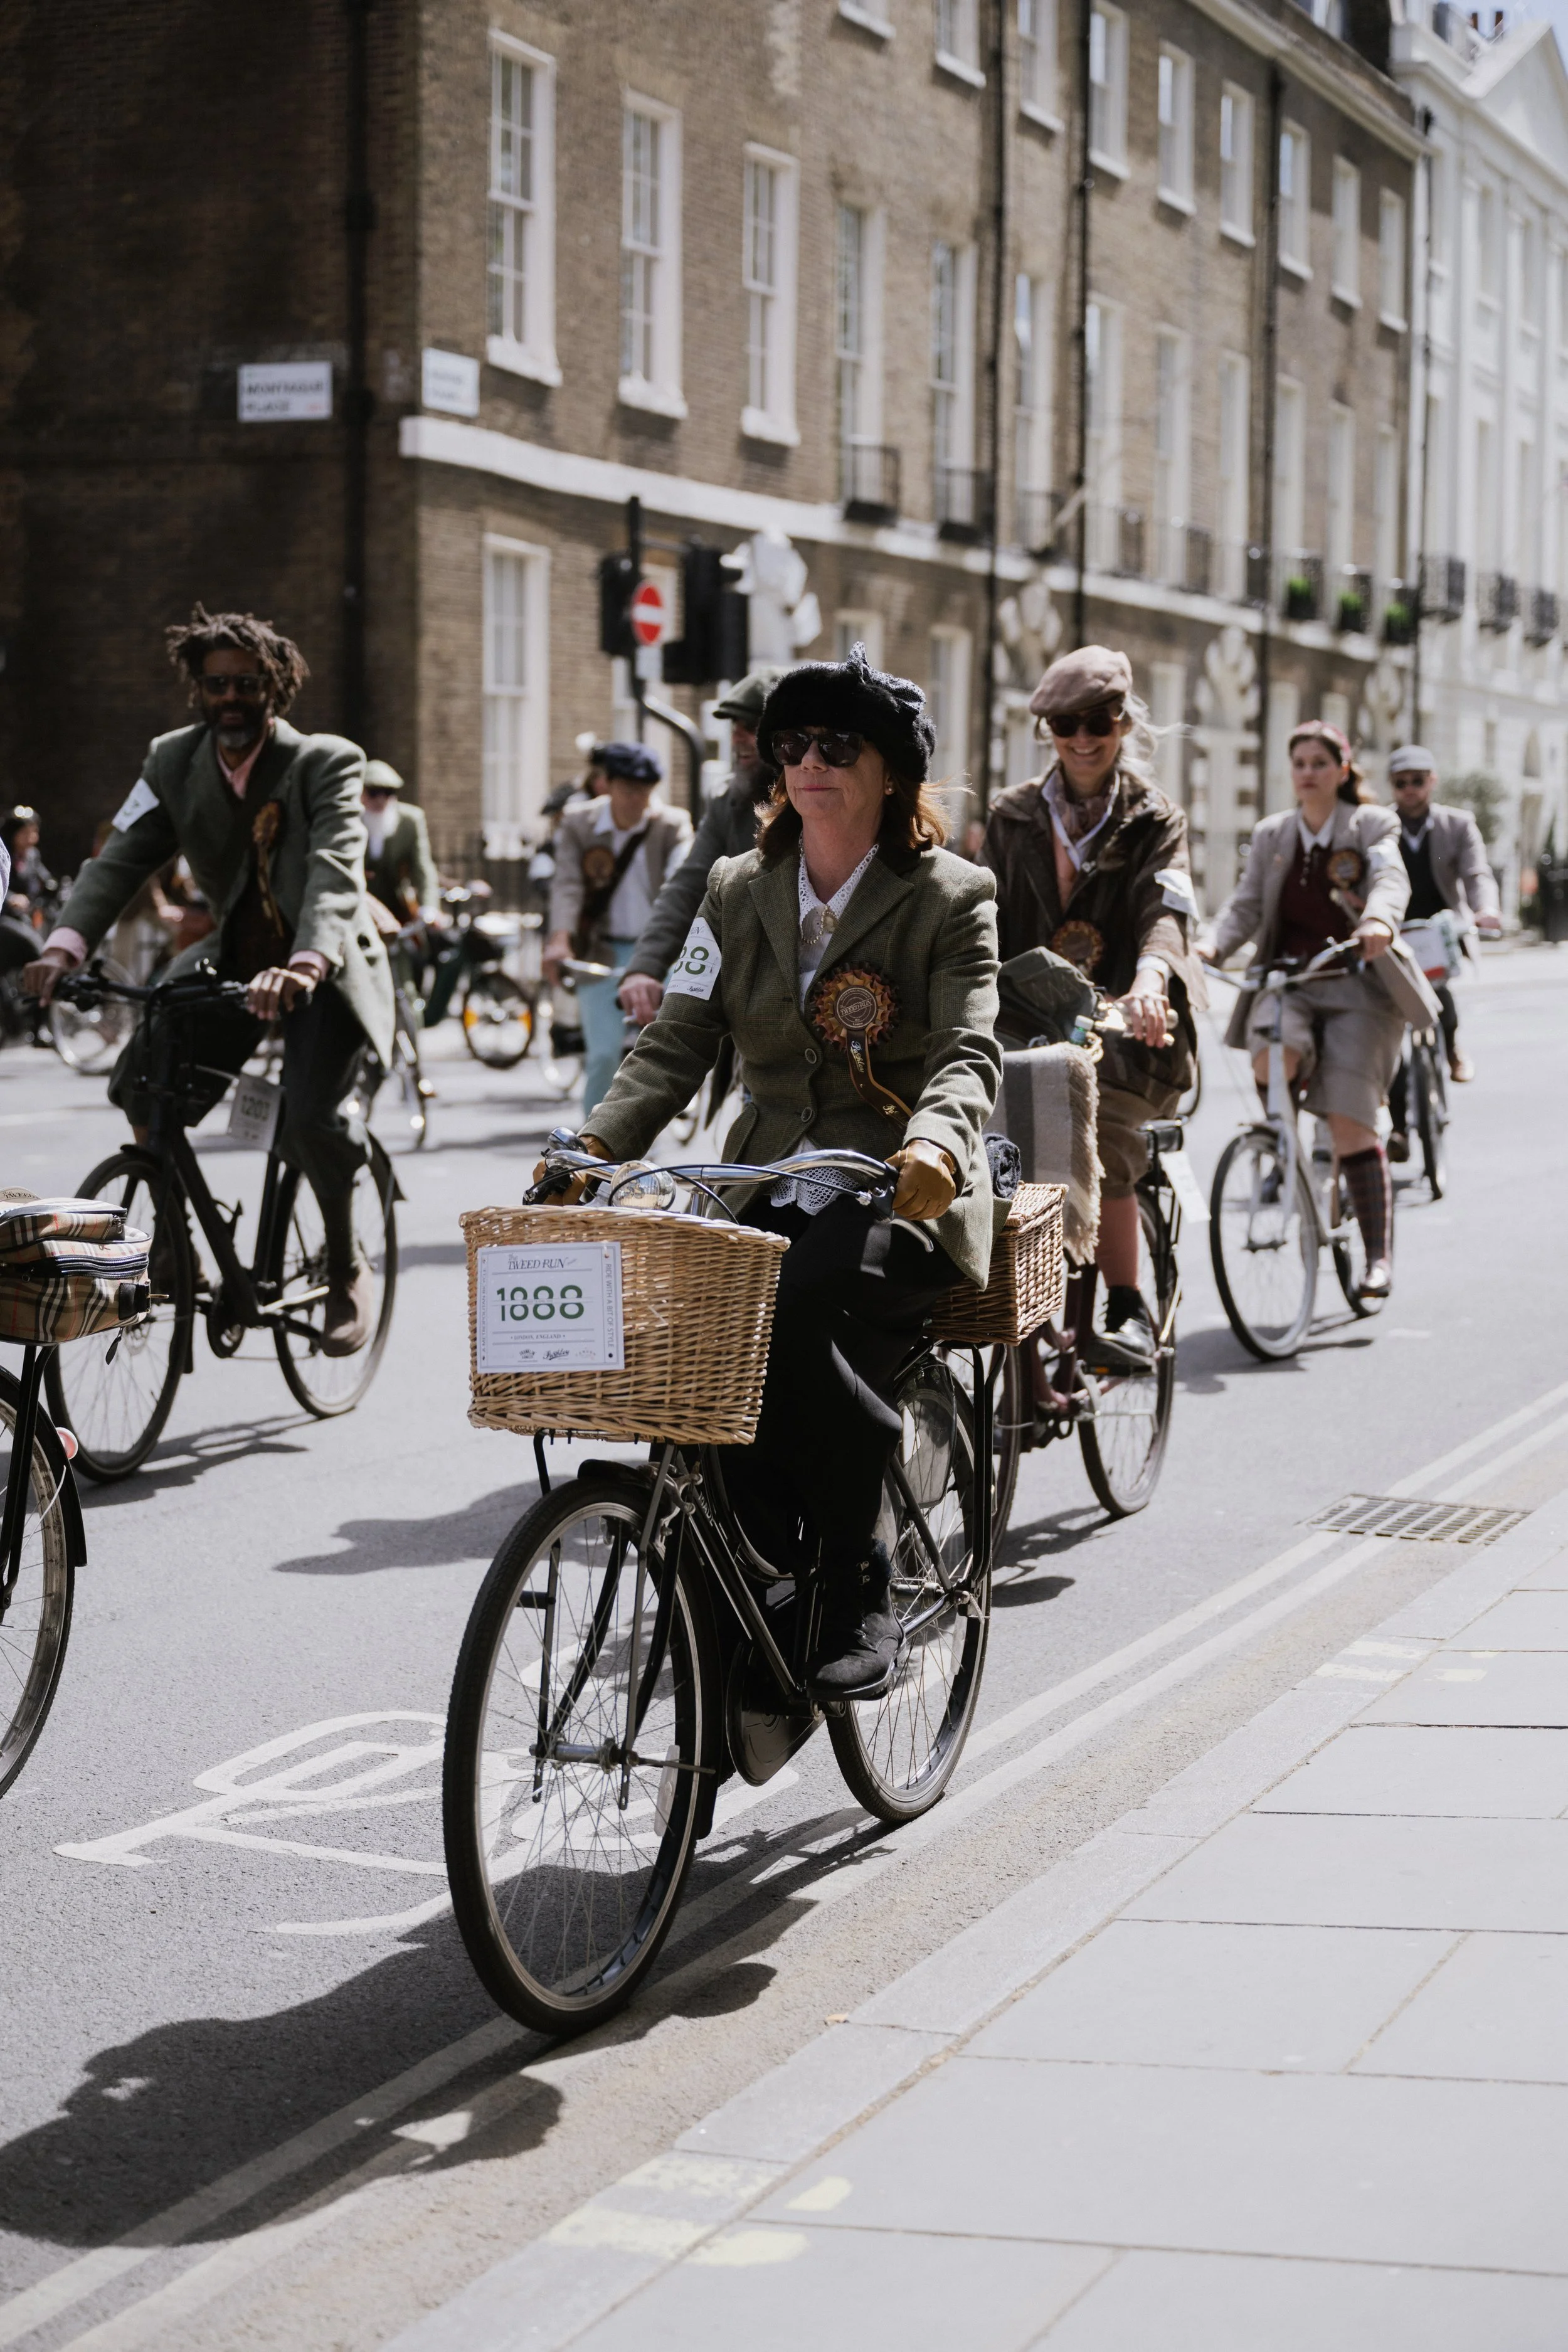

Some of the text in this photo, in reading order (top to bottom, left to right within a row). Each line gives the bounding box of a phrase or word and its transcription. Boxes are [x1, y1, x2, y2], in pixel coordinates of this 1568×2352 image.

[841, 999, 872, 1015] TWEED RUN
[508, 1259, 541, 1270] TWEED
[542, 1257, 568, 1269] RUN
[496, 1285, 585, 1322] 1888
[607, 1316, 613, 1326] OF
